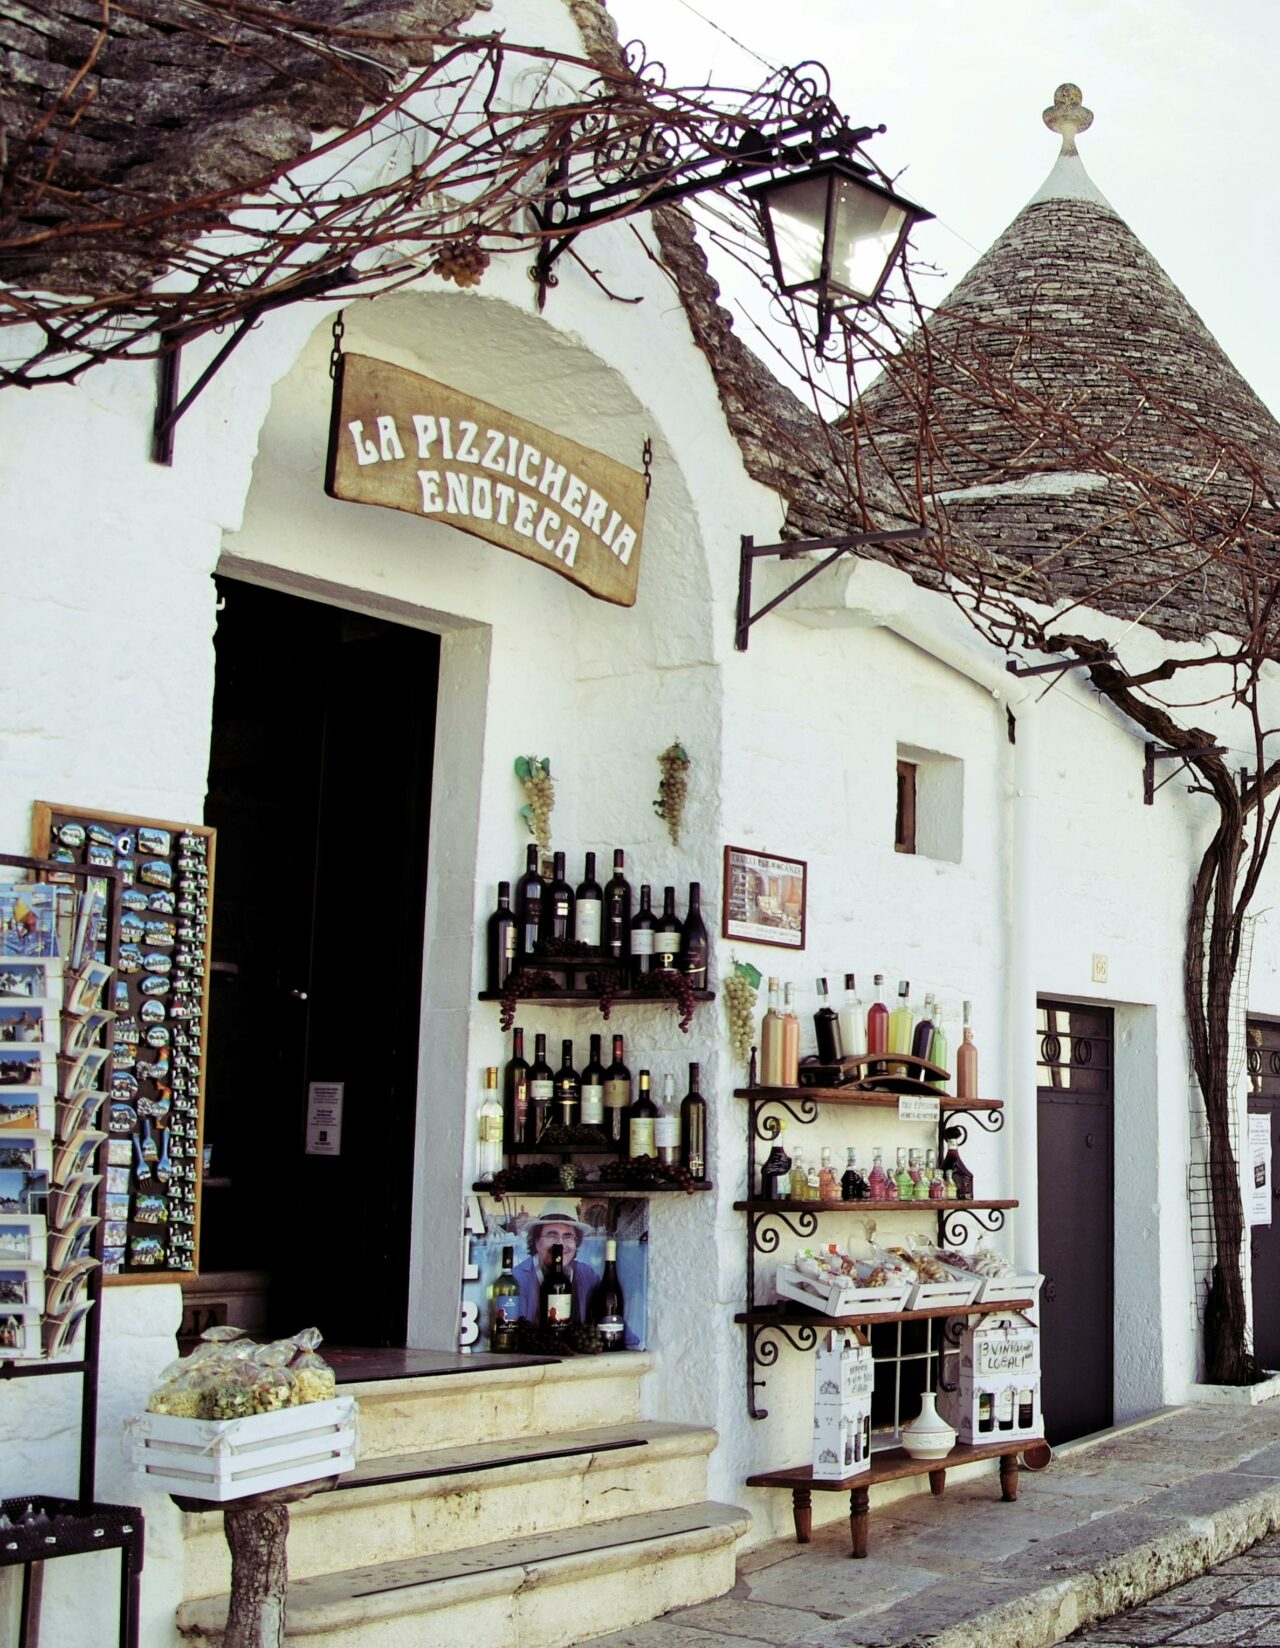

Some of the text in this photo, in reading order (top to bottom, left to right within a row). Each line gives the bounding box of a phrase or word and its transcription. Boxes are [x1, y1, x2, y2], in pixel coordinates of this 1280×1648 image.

[348, 414, 637, 565] LA PIZZICHERIA
[417, 470, 581, 567] ENOTECA
[983, 1342, 990, 1357] 3
